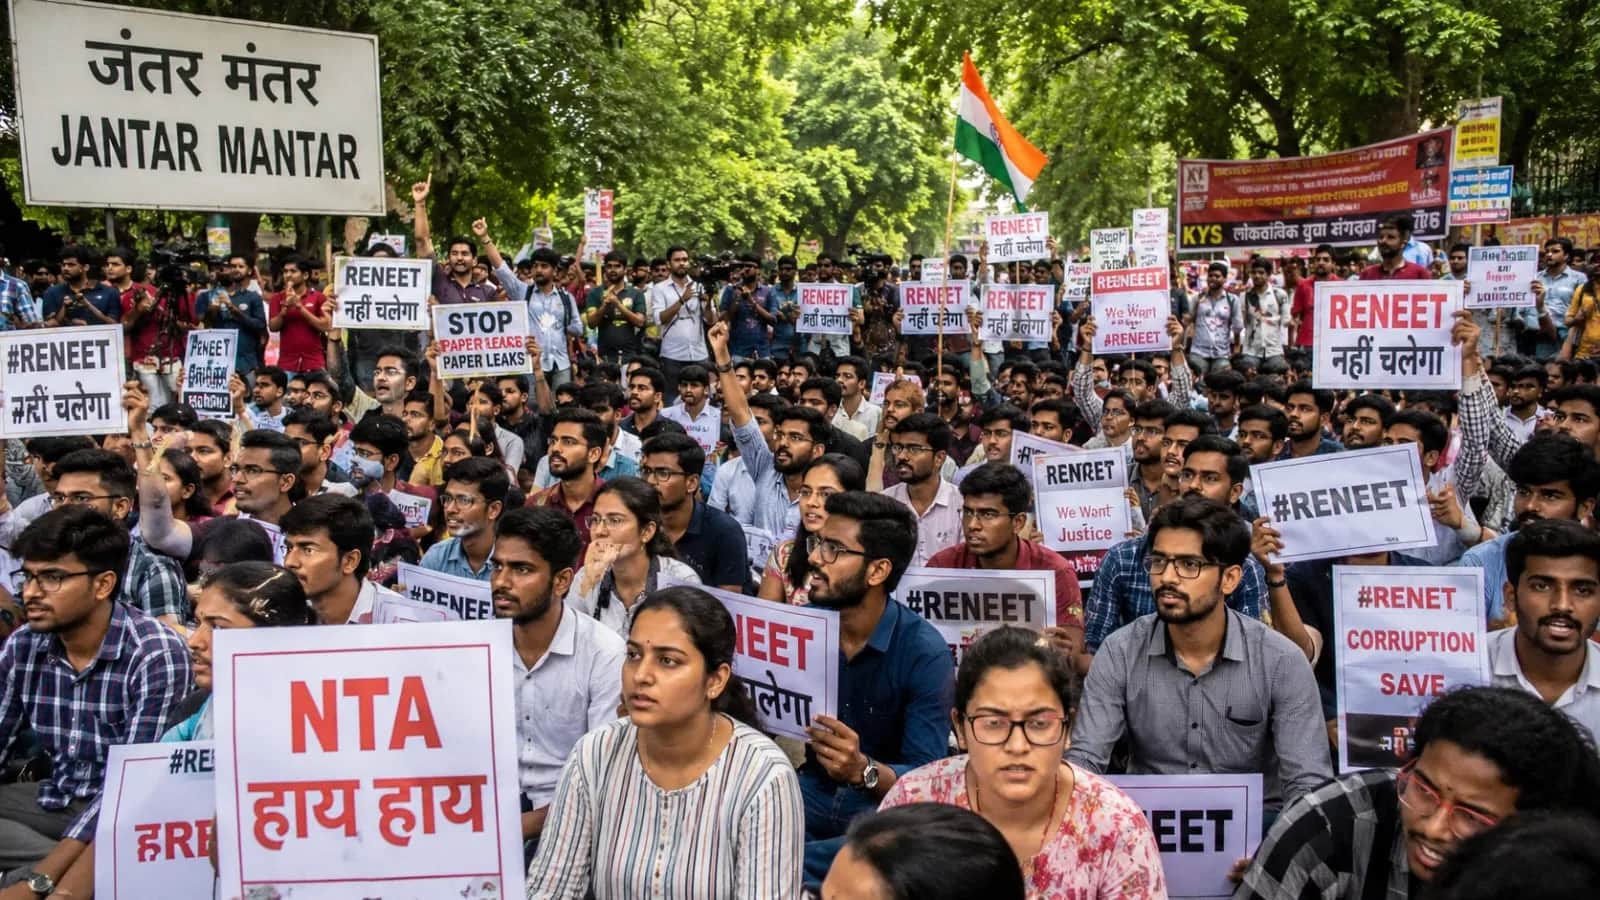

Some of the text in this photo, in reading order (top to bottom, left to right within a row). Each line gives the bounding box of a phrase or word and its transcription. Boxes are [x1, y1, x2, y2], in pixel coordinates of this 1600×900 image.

[85, 28, 321, 106] जंतर मंतर
[52, 114, 360, 180] JANTAR MANTAR
[991, 217, 1042, 236] RENEET
[1183, 224, 1223, 245] KYS
[345, 266, 421, 288] RENEET
[802, 288, 848, 305] RENEET
[906, 286, 963, 305] RENEET
[987, 291, 1047, 311] RENEET
[344, 294, 419, 322] नहीं चलेगा
[908, 307, 929, 330] नहीं
[1330, 294, 1447, 329] RENEET
[449, 311, 513, 335] STOP
[987, 312, 1009, 336] नहीं
[8, 339, 109, 374] #RENEET
[443, 352, 525, 369] PAPER LEAKS
[1331, 334, 1445, 380] नहीं चलेगा
[53, 381, 112, 422] चलेगा
[1056, 506, 1076, 519] We
[1272, 479, 1408, 523] #RENEET
[1058, 526, 1113, 543] Justice
[906, 589, 1036, 622] #RENEET
[1358, 586, 1457, 610] #RENET
[1347, 629, 1475, 653] CORRUPTION
[1380, 672, 1445, 697] SAVE
[290, 675, 442, 754] NTA
[247, 775, 487, 851] हाय हाय
